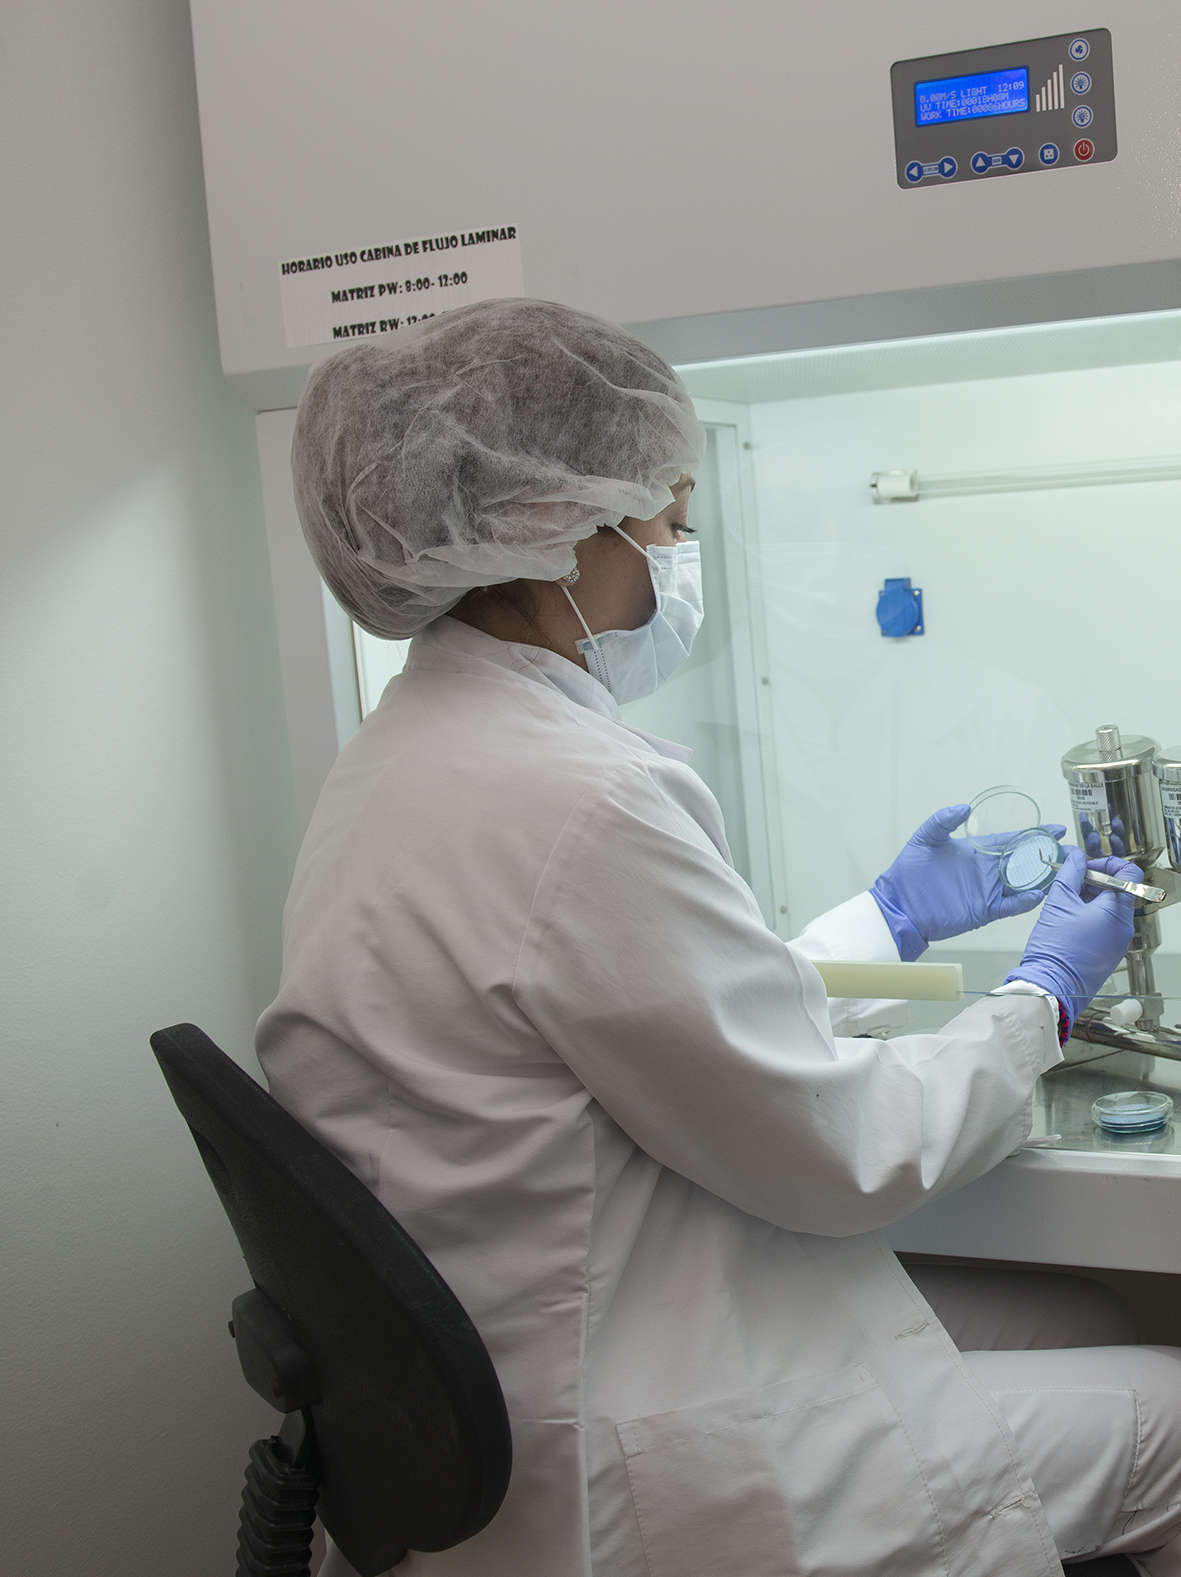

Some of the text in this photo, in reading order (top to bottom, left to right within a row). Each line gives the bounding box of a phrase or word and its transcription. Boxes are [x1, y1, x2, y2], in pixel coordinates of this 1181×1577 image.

[960, 86, 988, 98] LIGHT
[998, 81, 1024, 93] 12:09
[920, 110, 942, 121] WORK
[281, 226, 517, 275] HORARIO USO CABINA DE FLUJO LAMINAR
[331, 284, 376, 304] MATRIZ
[378, 281, 403, 297] PW:
[438, 271, 468, 288] 12:00
[332, 320, 377, 339] MATRIZ
